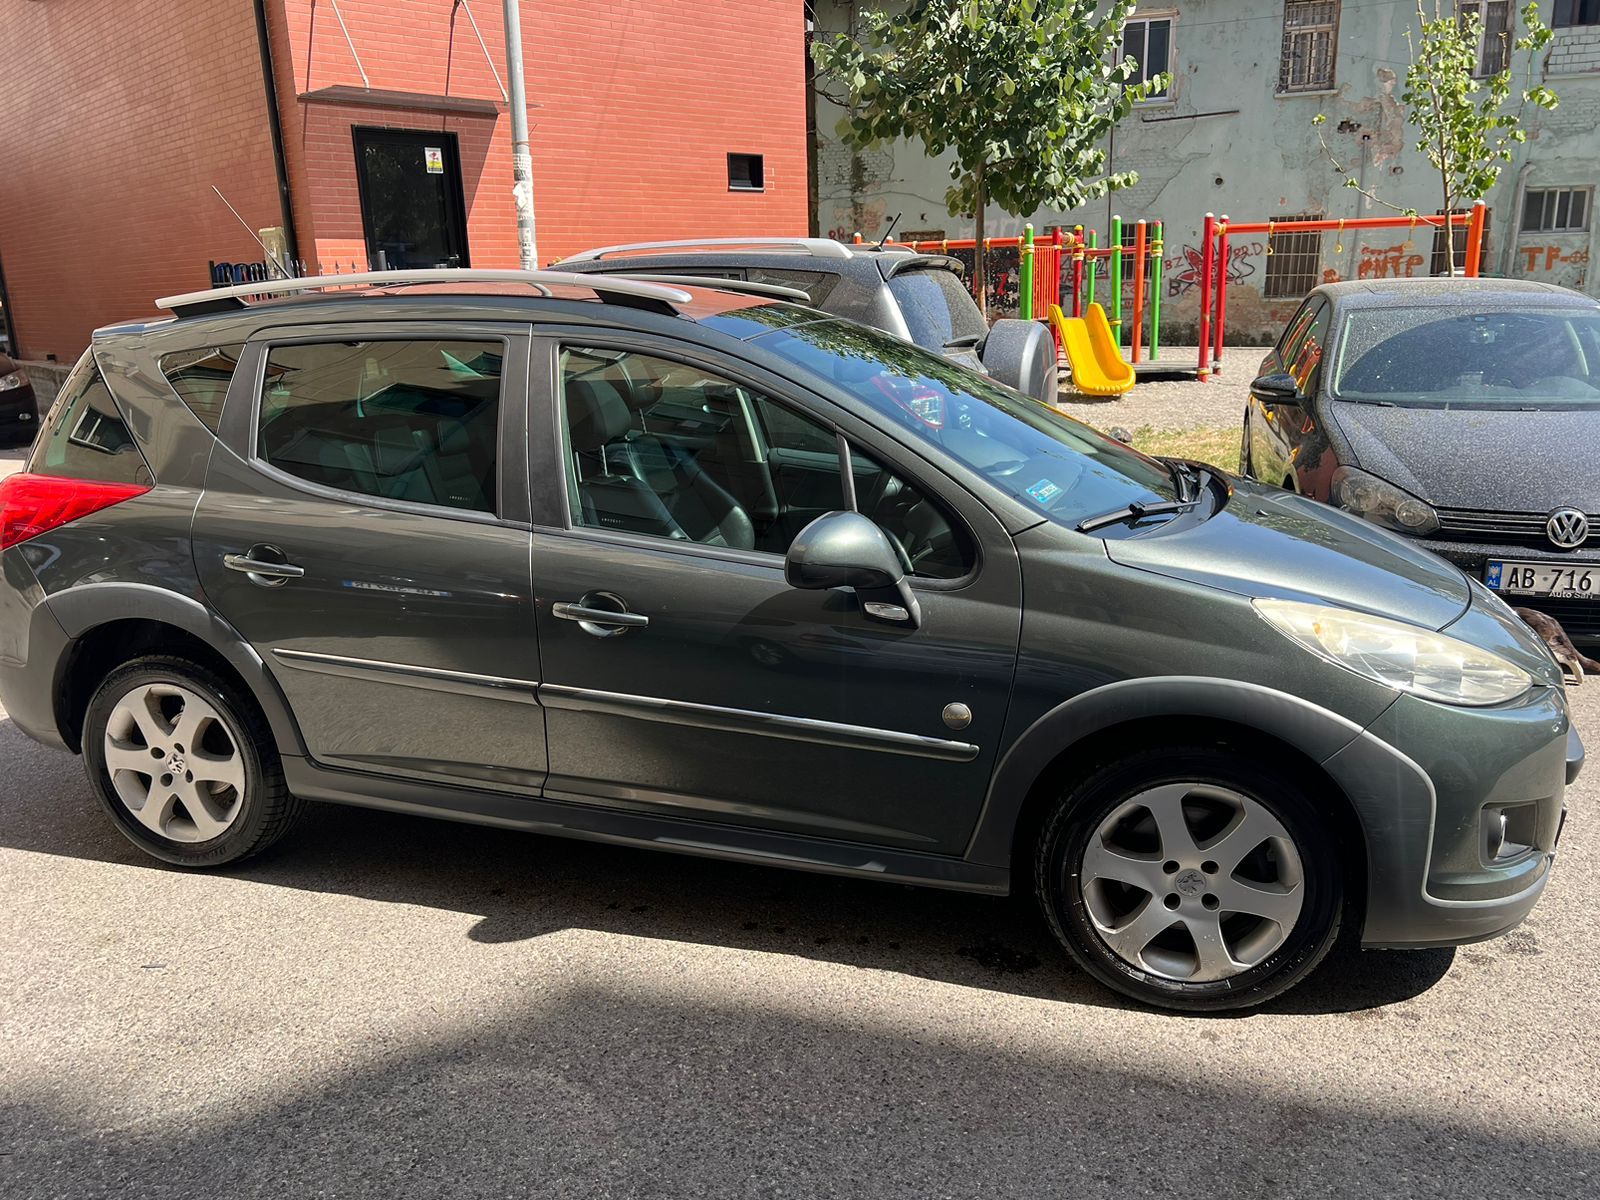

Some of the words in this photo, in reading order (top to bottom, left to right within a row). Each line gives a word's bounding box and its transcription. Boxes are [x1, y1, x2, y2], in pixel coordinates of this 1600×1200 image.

[1487, 579, 1499, 587] AL
[1507, 568, 1536, 588] AB
[1550, 569, 1592, 591] 716
[1548, 590, 1572, 598] Auto
